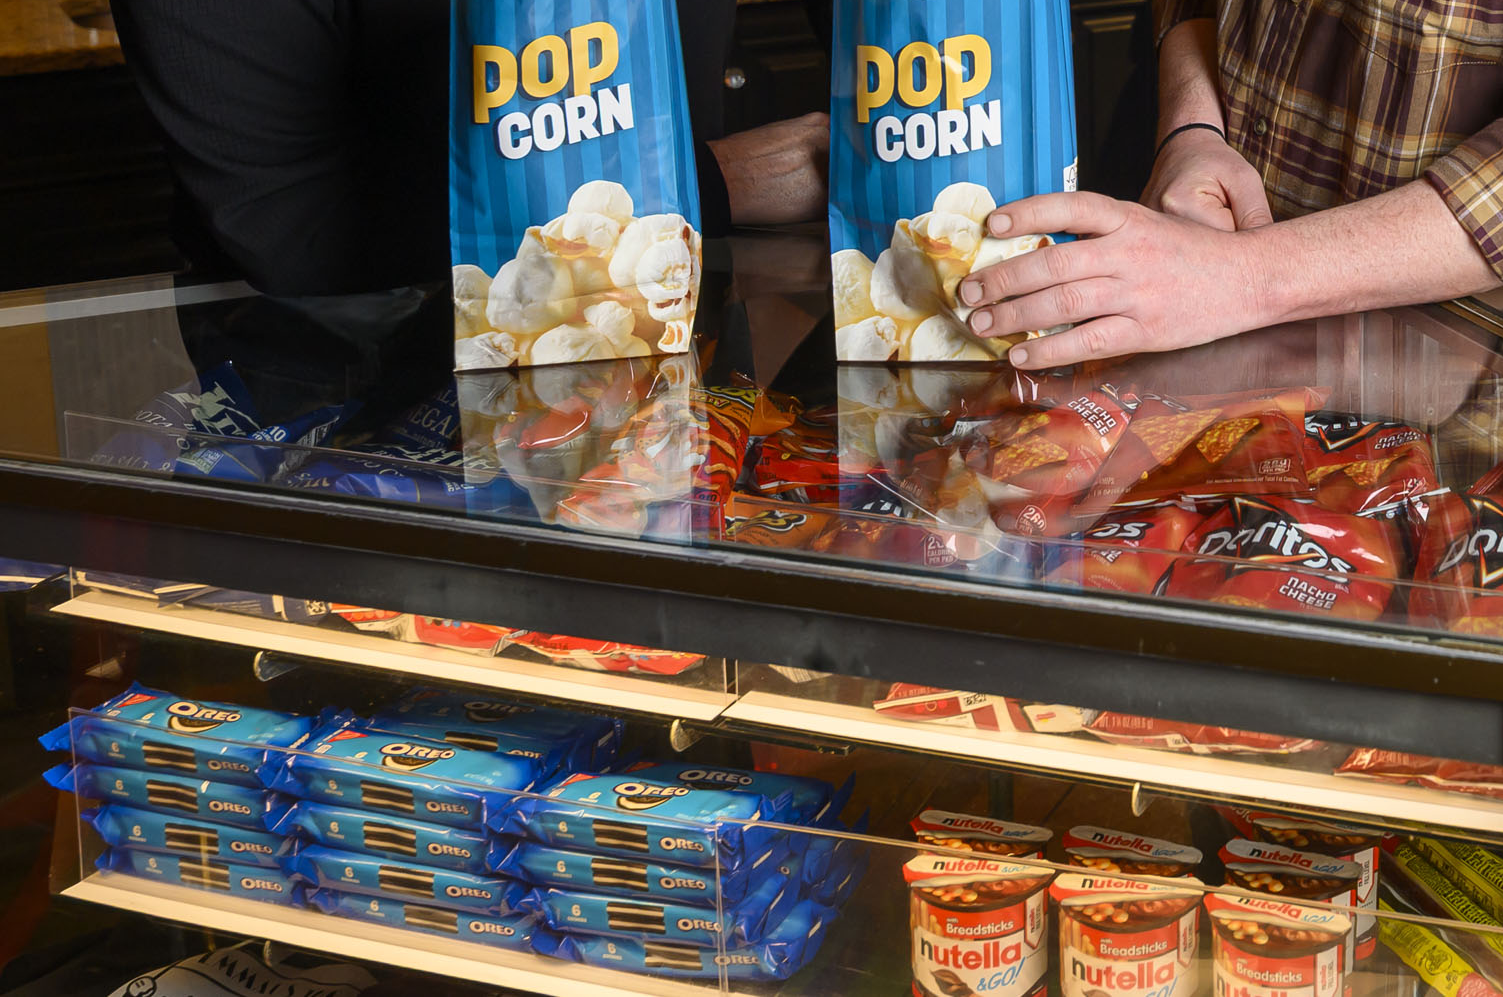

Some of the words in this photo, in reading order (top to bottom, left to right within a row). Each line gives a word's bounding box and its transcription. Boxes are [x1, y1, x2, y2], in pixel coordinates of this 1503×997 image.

[472, 22, 618, 124] POP
[857, 34, 991, 122] POP
[497, 83, 634, 159] CORN
[875, 100, 1002, 163] CORN
[1067, 400, 1111, 437] CHEESE
[1077, 396, 1118, 427] NACHO
[1196, 520, 1356, 585] Doritos
[1279, 585, 1336, 610] CHEESE
[1289, 577, 1337, 601] NACHO
[167, 701, 242, 723] OREO
[379, 742, 456, 762] OREO
[208, 759, 250, 774] OREO
[678, 769, 753, 787] OREO
[614, 781, 690, 799] OREO
[209, 800, 251, 815] OREO
[426, 800, 469, 815] OREO
[942, 816, 1004, 834] nutella
[231, 841, 273, 855] OREO
[428, 843, 471, 859] OREO
[659, 837, 705, 852] OREO
[1092, 831, 1153, 853] nutella
[932, 859, 999, 872] nutella
[1249, 847, 1314, 869] nutella
[241, 877, 283, 893] OREO
[445, 885, 492, 900] OREO
[659, 876, 706, 891] OREO
[1081, 877, 1149, 891] nutella
[469, 920, 515, 937] OREO
[677, 917, 723, 933] OREO
[946, 921, 1014, 936] Breadsticks
[920, 936, 1022, 971] nutella
[1100, 940, 1168, 956] Breadsticks
[976, 957, 1028, 993] &GO!
[1071, 954, 1175, 988] nutella
[1236, 961, 1303, 983] Breadsticks
